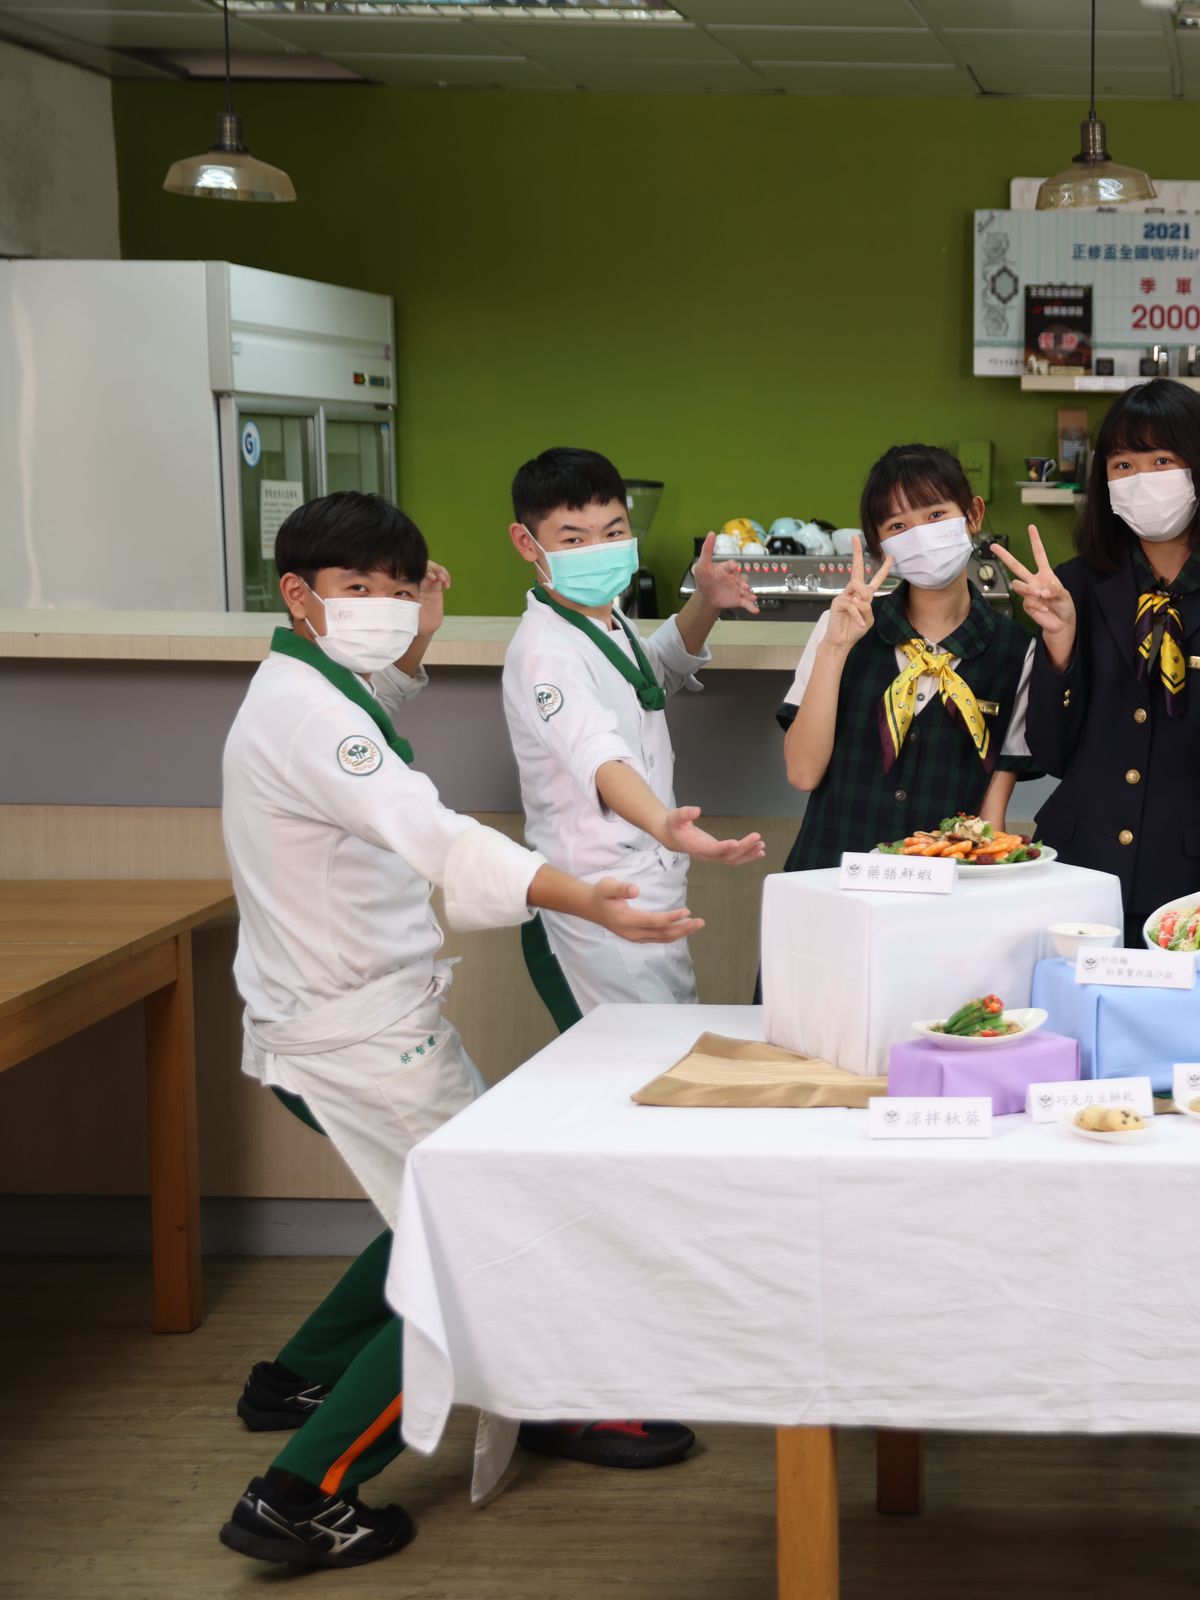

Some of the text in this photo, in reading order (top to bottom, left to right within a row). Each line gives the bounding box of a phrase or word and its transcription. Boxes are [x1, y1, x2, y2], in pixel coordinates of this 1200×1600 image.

[1142, 221, 1191, 241] 2021
[866, 864, 933, 882] 藥膳鮮蝦
[1056, 1090, 1136, 1107] 巧克力豆餅乾
[905, 1109, 982, 1126] 涼拌秋葵
